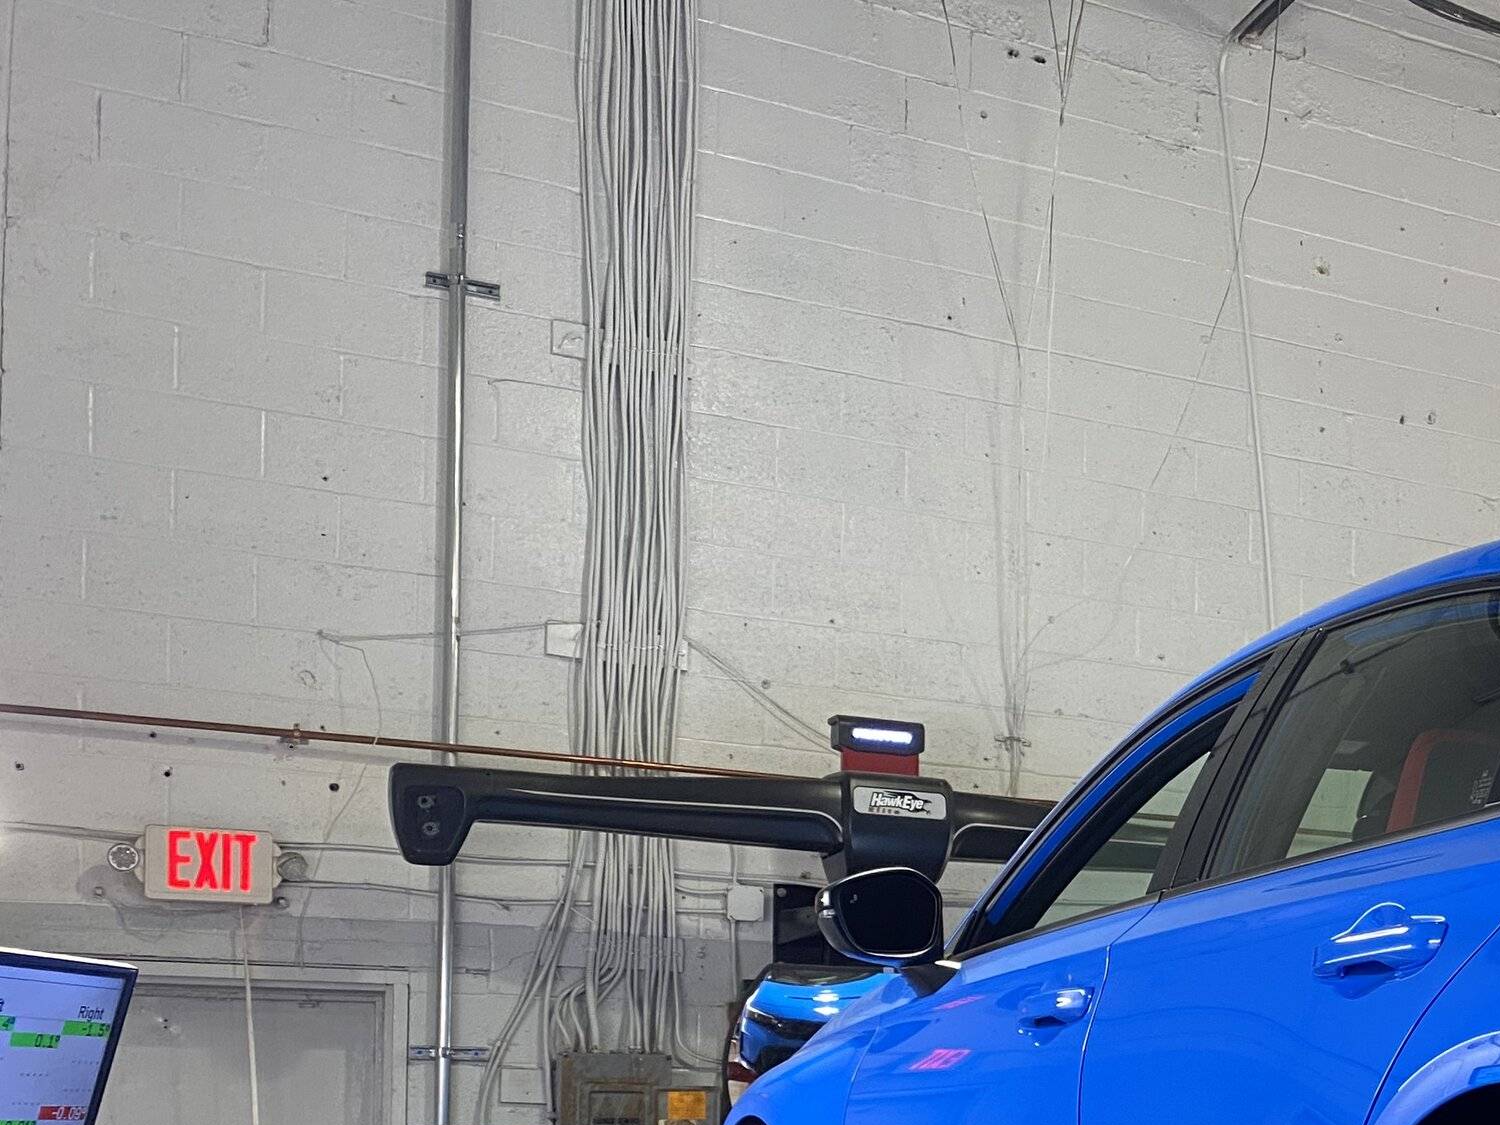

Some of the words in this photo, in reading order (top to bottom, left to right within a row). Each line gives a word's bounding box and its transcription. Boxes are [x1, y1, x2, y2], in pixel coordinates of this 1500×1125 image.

[871, 792, 924, 811] HawkEye
[167, 830, 257, 892] EXIT
[78, 1005, 104, 1022] Right
